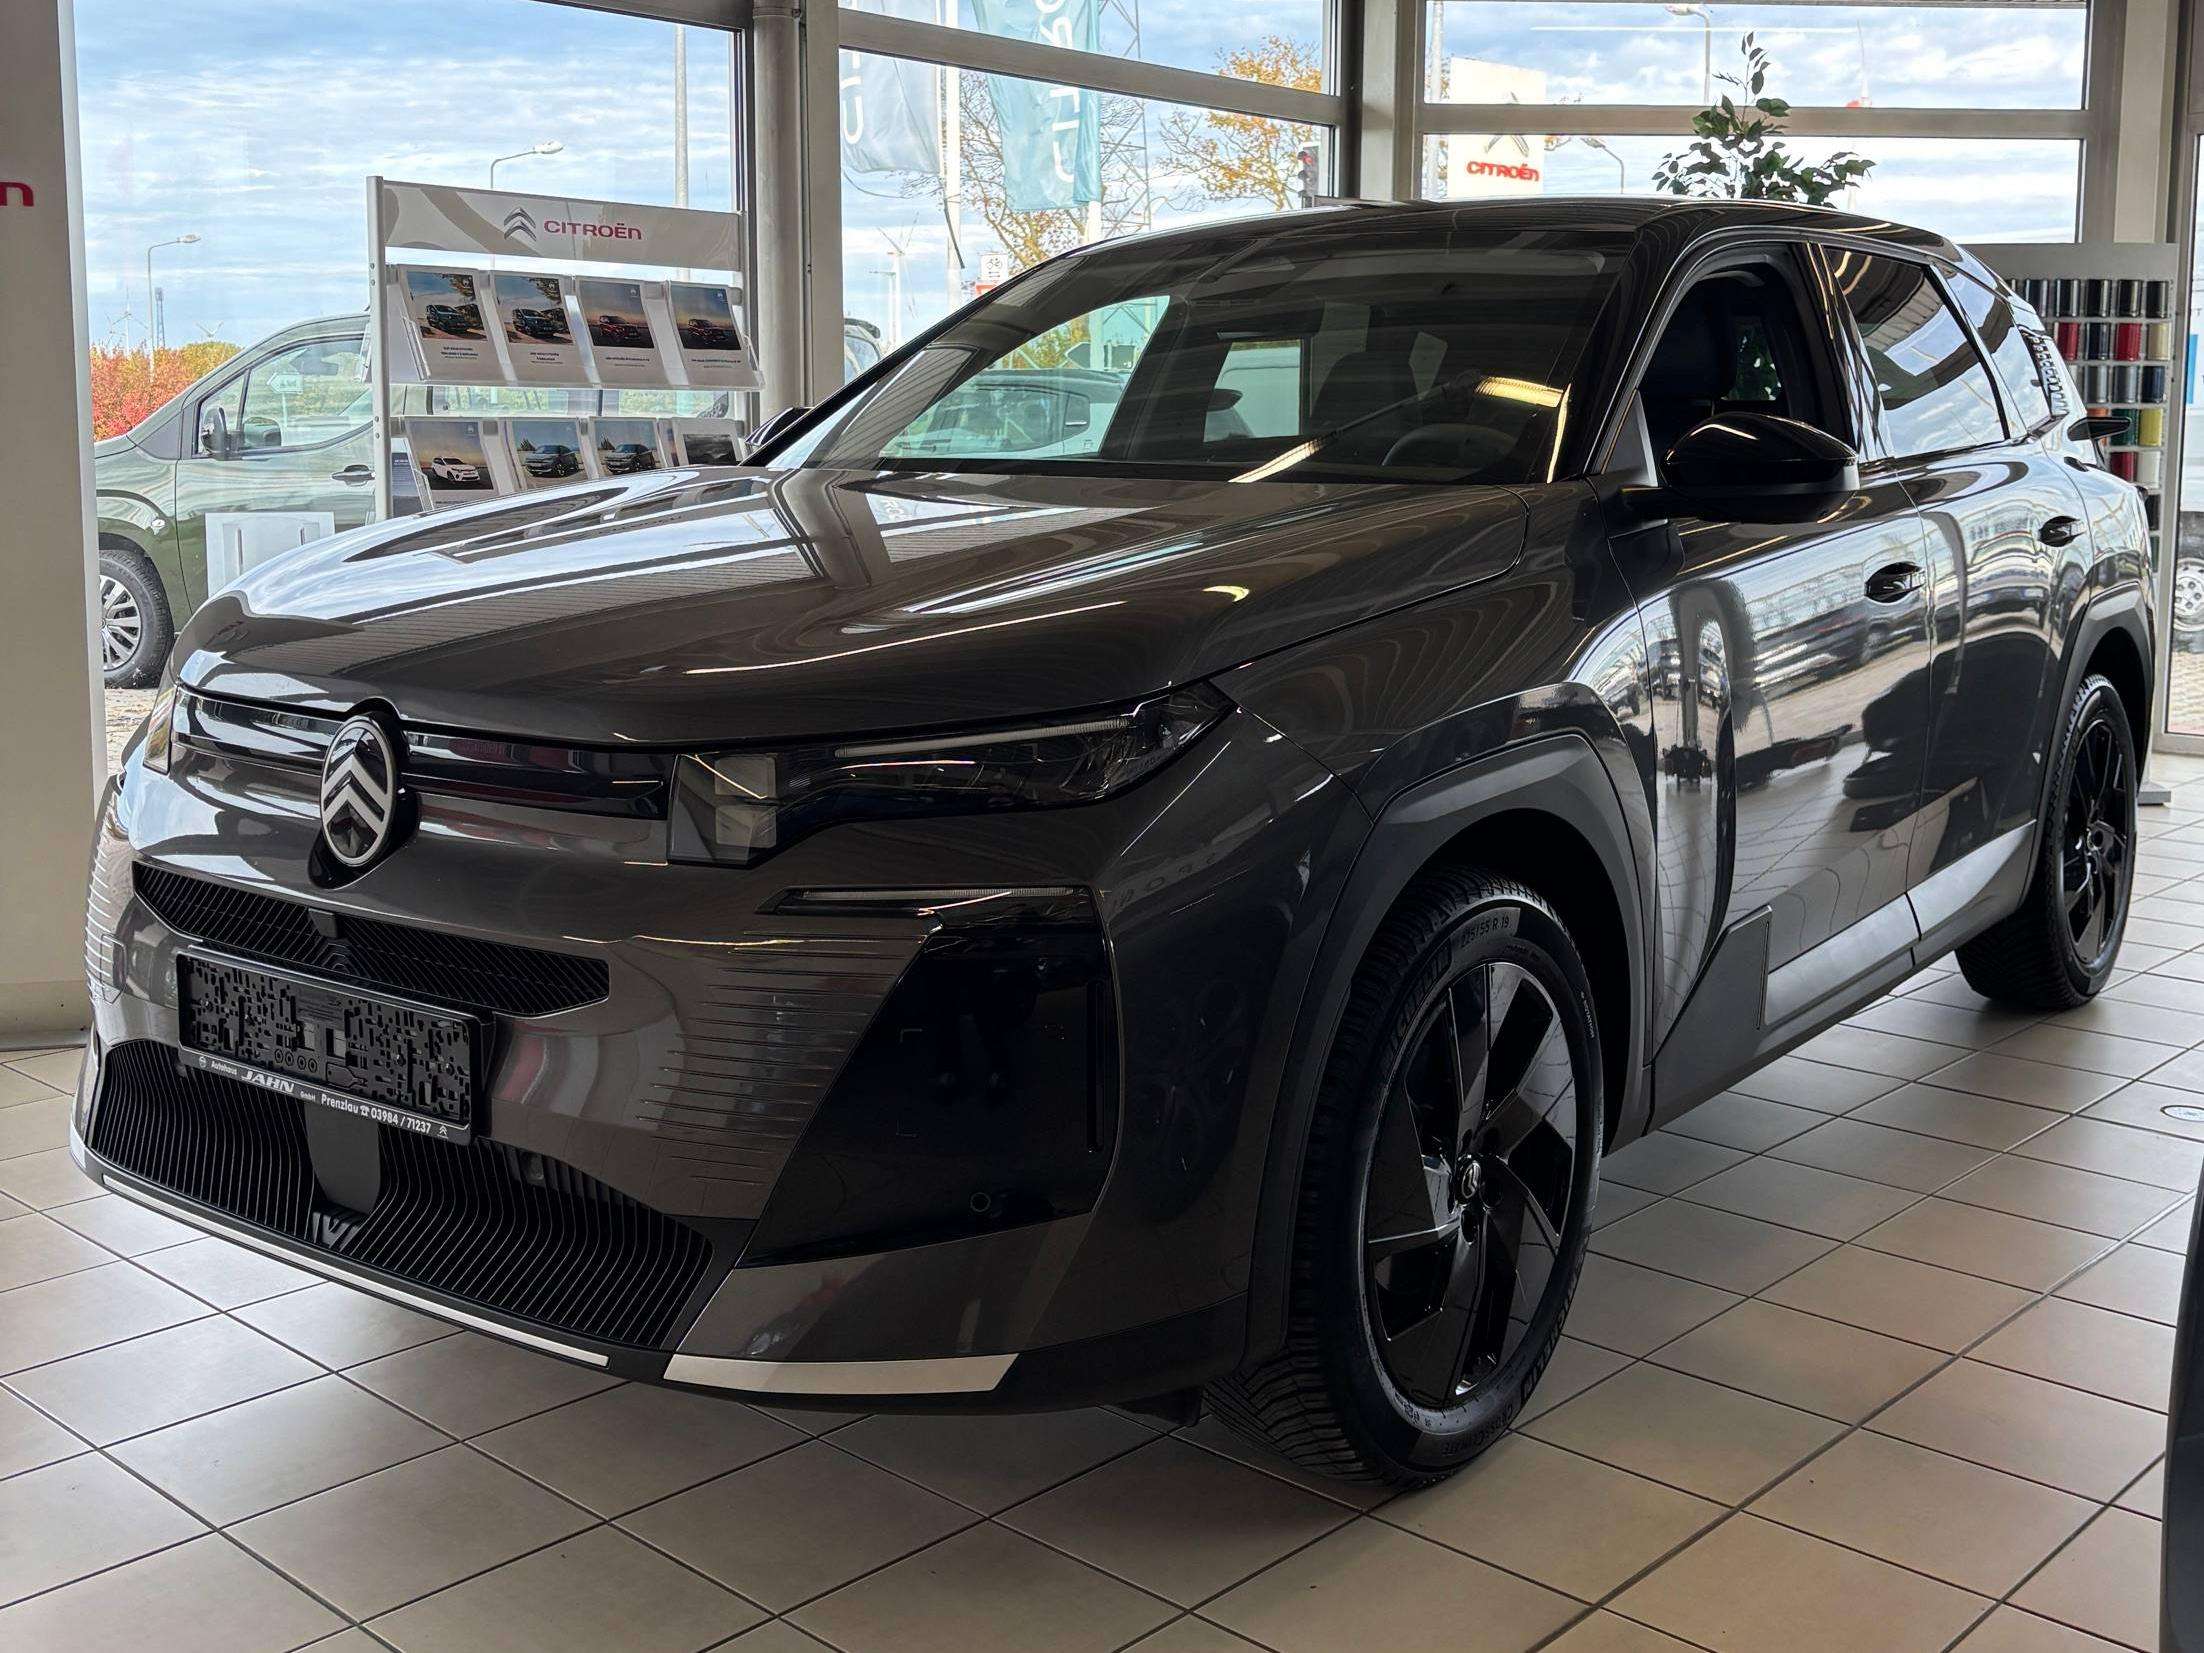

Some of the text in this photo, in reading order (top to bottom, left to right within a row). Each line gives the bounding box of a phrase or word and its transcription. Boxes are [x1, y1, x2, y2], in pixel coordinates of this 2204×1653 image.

[210, 1060, 238, 1076] Autohaus
[241, 1070, 295, 1093] JAHN
[300, 1090, 317, 1102] GmbH
[321, 1093, 359, 1115] Prenzlau
[370, 1107, 399, 1126] 03984
[406, 1118, 432, 1135] 71237
